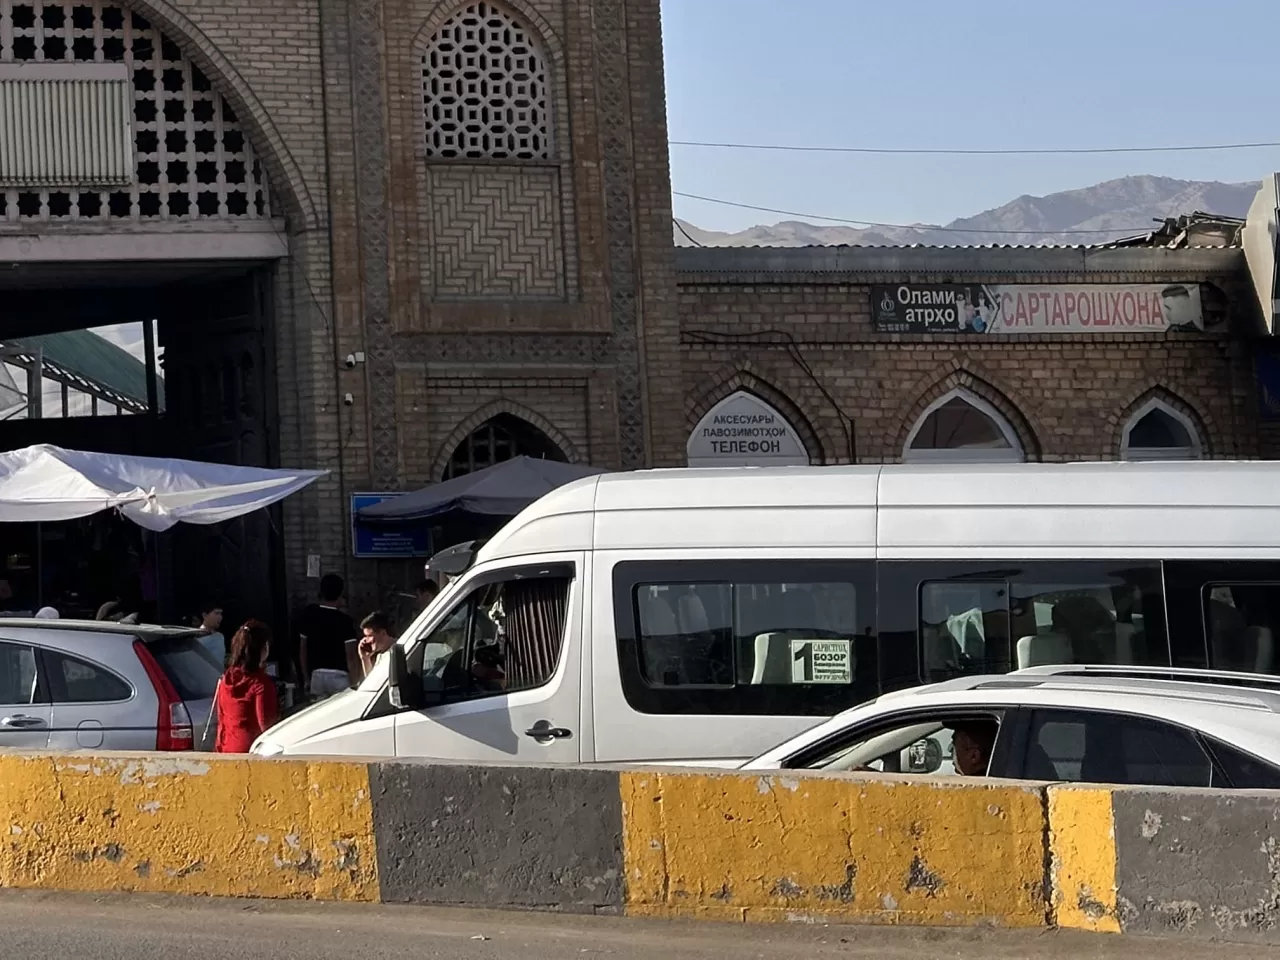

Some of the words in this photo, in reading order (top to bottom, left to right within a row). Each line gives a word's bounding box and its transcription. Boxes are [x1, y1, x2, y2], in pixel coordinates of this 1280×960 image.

[897, 286, 957, 305] Олами
[1001, 291, 1166, 327] САРТАРОШХОНА
[713, 414, 775, 425] АКСЕСУАРЫ
[710, 440, 780, 453] ТЕЛЕФОН
[794, 642, 813, 681] 1
[813, 653, 847, 661] БОЗОР
